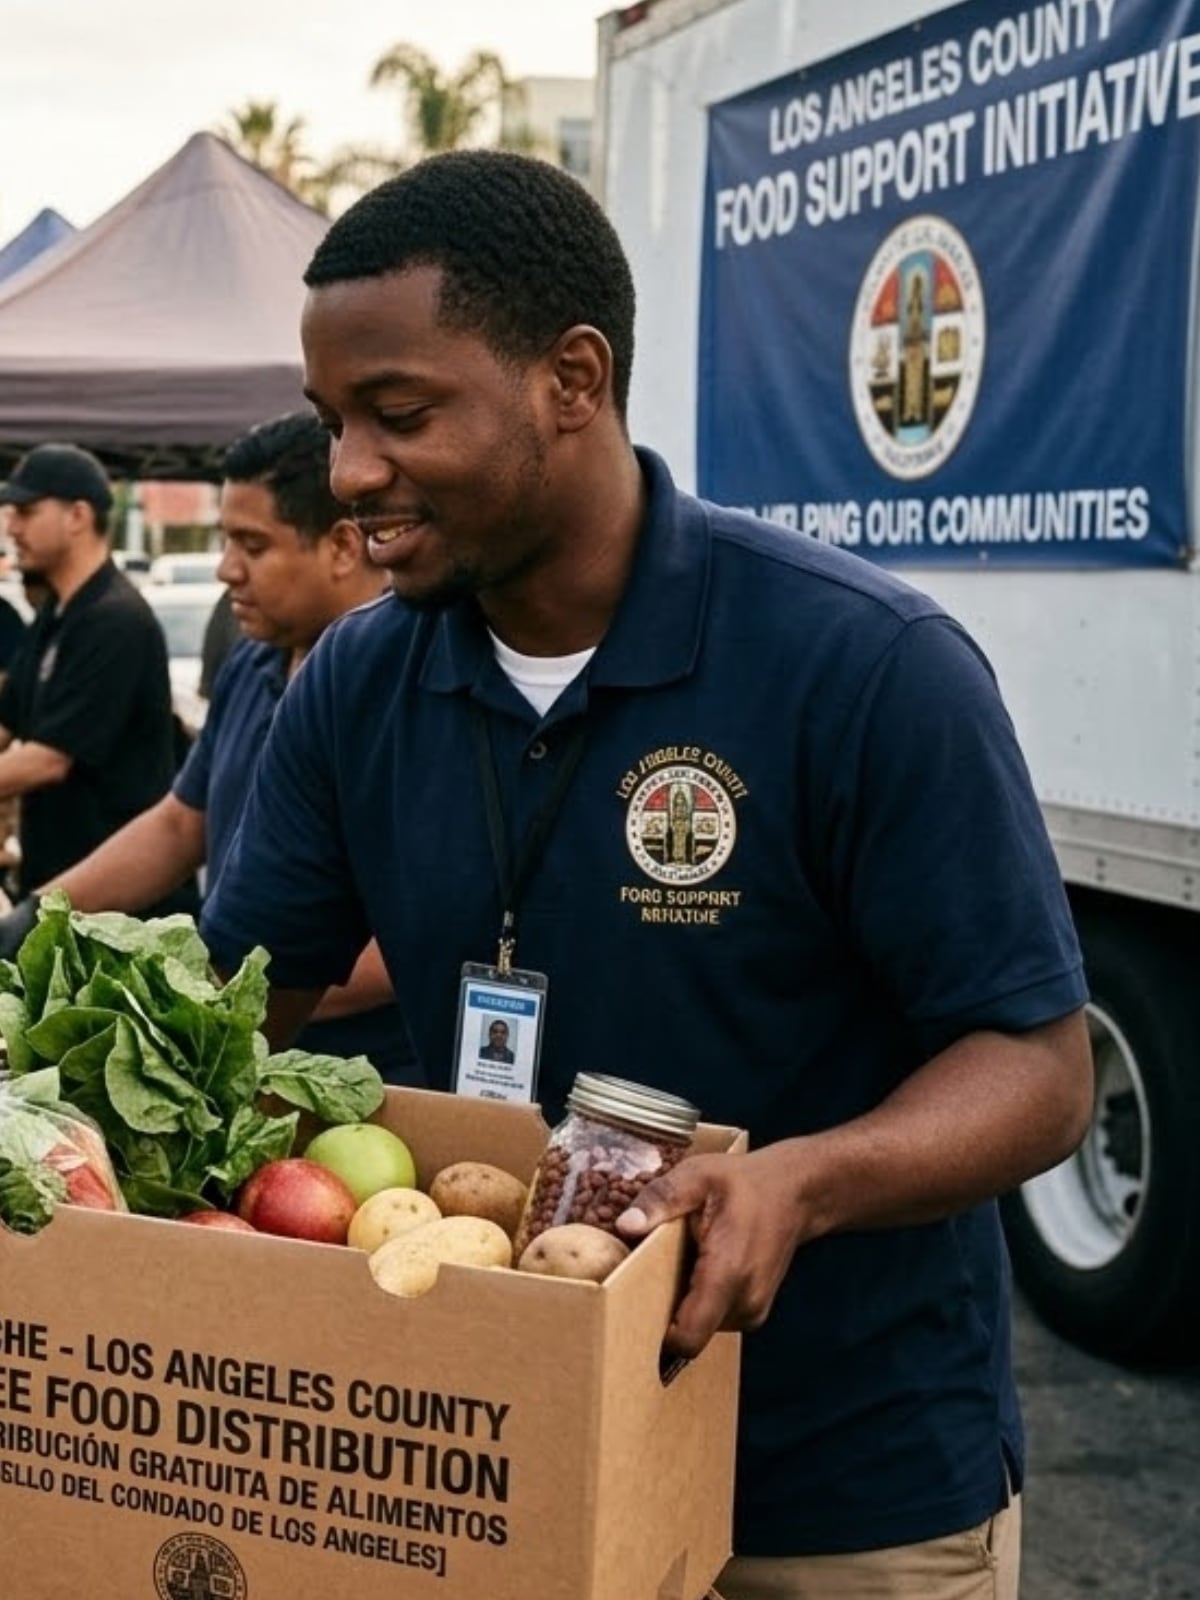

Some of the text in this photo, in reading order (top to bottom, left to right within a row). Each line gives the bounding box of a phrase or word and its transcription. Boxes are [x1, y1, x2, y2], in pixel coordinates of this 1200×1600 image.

[770, 0, 1116, 155] LOS ANGELES COUNTY
[715, 34, 1200, 249] FOOD SUPPORT INITIATIVE
[866, 499, 925, 546] OUR
[929, 487, 1150, 545] COMMUNITIES
[46, 1374, 161, 1437] FOOD
[177, 1399, 509, 1503] DISTRIBUTION
[86, 1334, 154, 1380] LOS
[164, 1349, 335, 1412] ANGELES
[347, 1379, 511, 1441] COUNTY
[61, 1472, 104, 1503] DEL
[110, 1482, 224, 1528] CONDADO
[231, 1506, 263, 1536] DE
[270, 1514, 316, 1547] LOS
[323, 1526, 447, 1578] ANGELES]
[129, 1447, 270, 1501] GRATUITA
[279, 1475, 318, 1510] DE
[326, 1485, 508, 1547] ALIMENTOS
